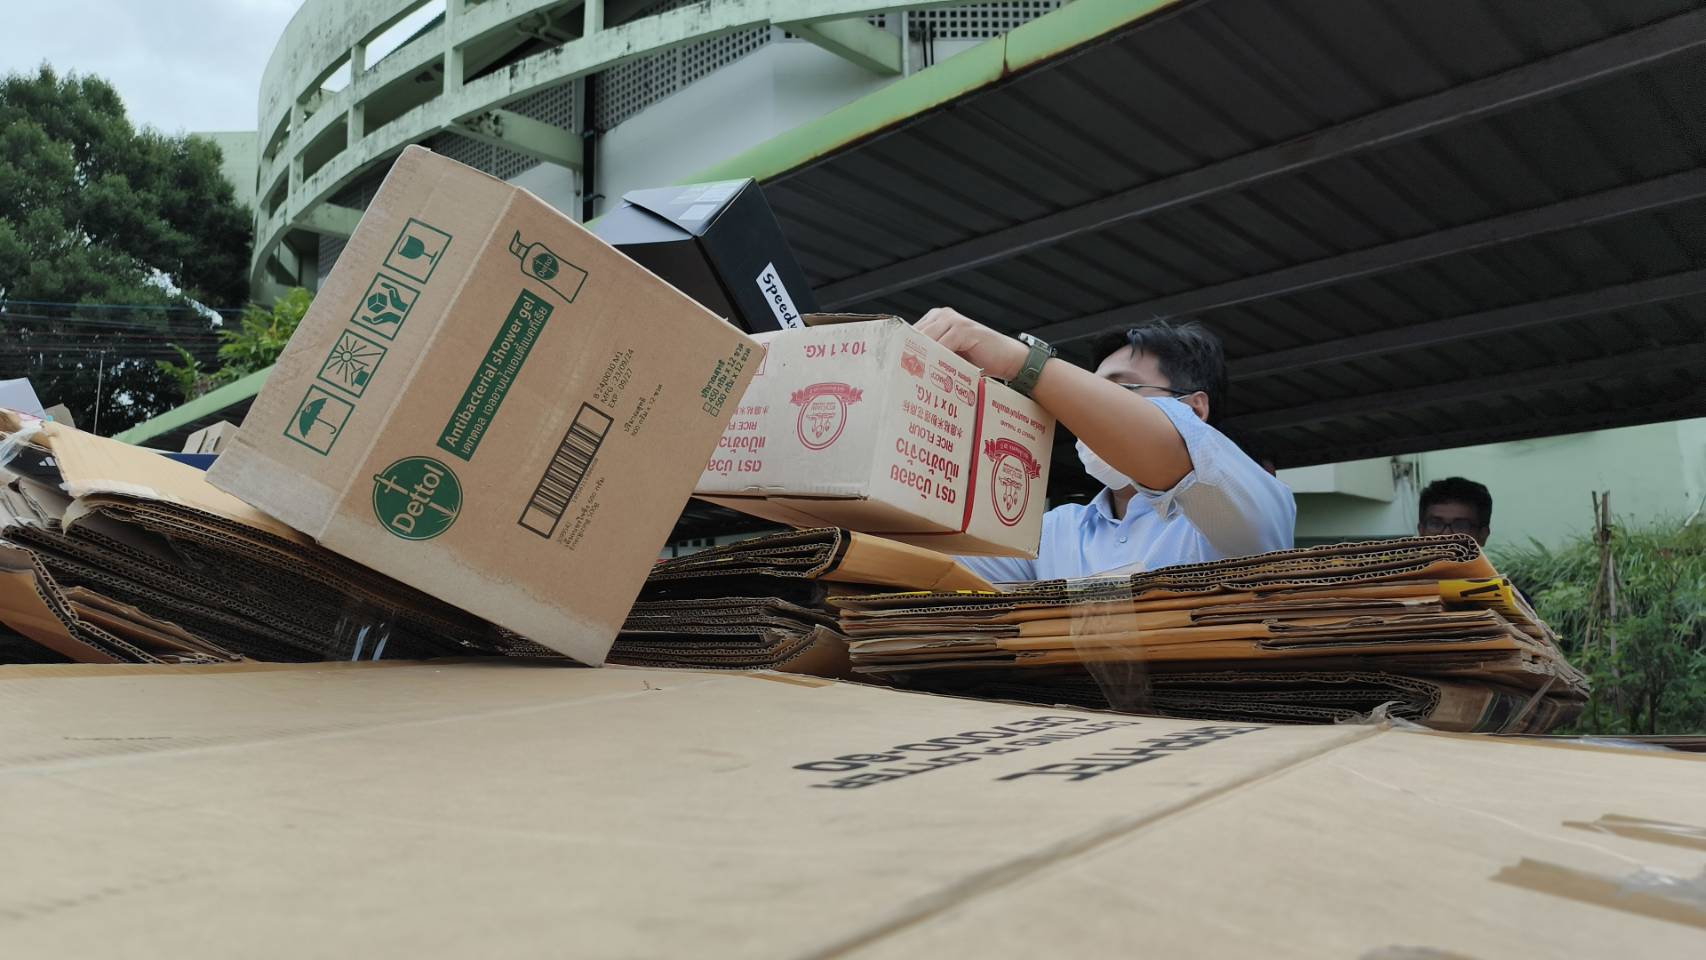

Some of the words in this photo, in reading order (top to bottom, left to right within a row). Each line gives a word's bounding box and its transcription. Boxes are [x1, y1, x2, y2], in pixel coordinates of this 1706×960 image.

[831, 343, 837, 357] 1
[852, 341, 867, 356] 10
[445, 363, 498, 448] Antibacterial
[493, 321, 522, 364] shower
[519, 295, 535, 321] gel
[948, 403, 958, 418] 10
[738, 421, 757, 431] RICE
[909, 422, 935, 444] FLOUR
[936, 437, 954, 452] RICE
[704, 459, 733, 476] บัวล
[737, 459, 762, 472] ตรา
[890, 464, 932, 499] บัวลอย
[392, 464, 444, 533] Dettol
[935, 483, 956, 504] ตรา
